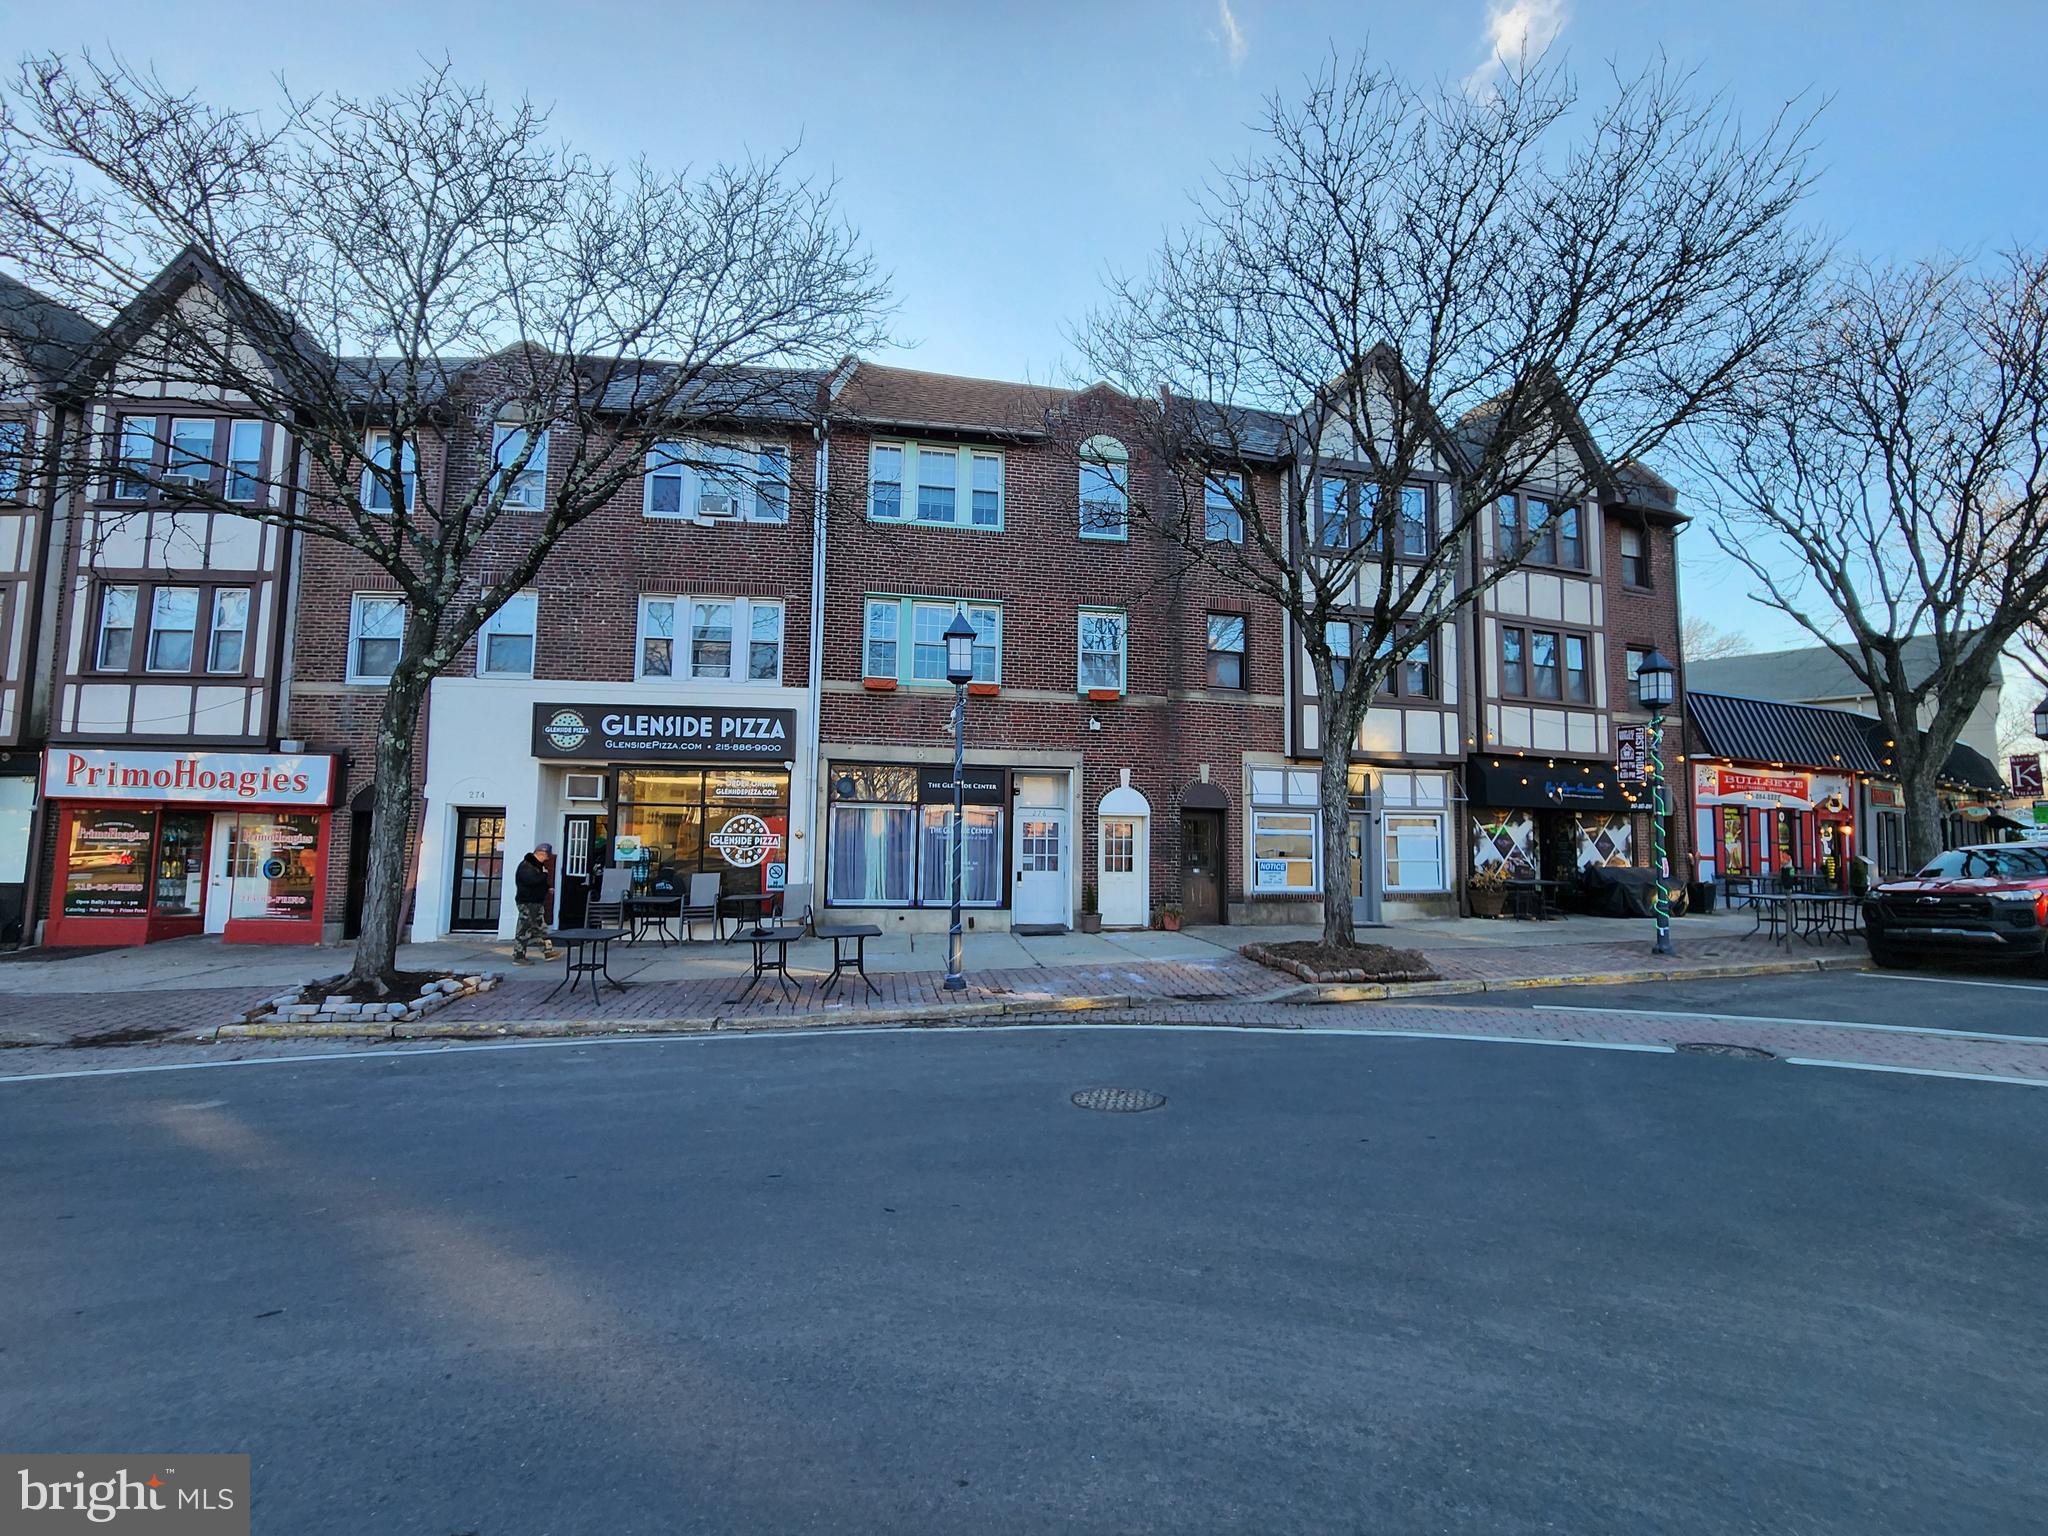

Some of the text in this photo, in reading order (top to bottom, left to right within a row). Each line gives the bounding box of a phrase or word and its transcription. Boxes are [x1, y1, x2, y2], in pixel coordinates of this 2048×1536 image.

[601, 714, 786, 739] GLENSIDE PIZZA
[715, 743, 782, 752] 215-886-9900
[65, 752, 309, 798] PrimoHoagies
[1725, 775, 1804, 789] BULLSEYE
[2012, 763, 2041, 788] K
[711, 836, 779, 845] GLENSIDE PIZZA
